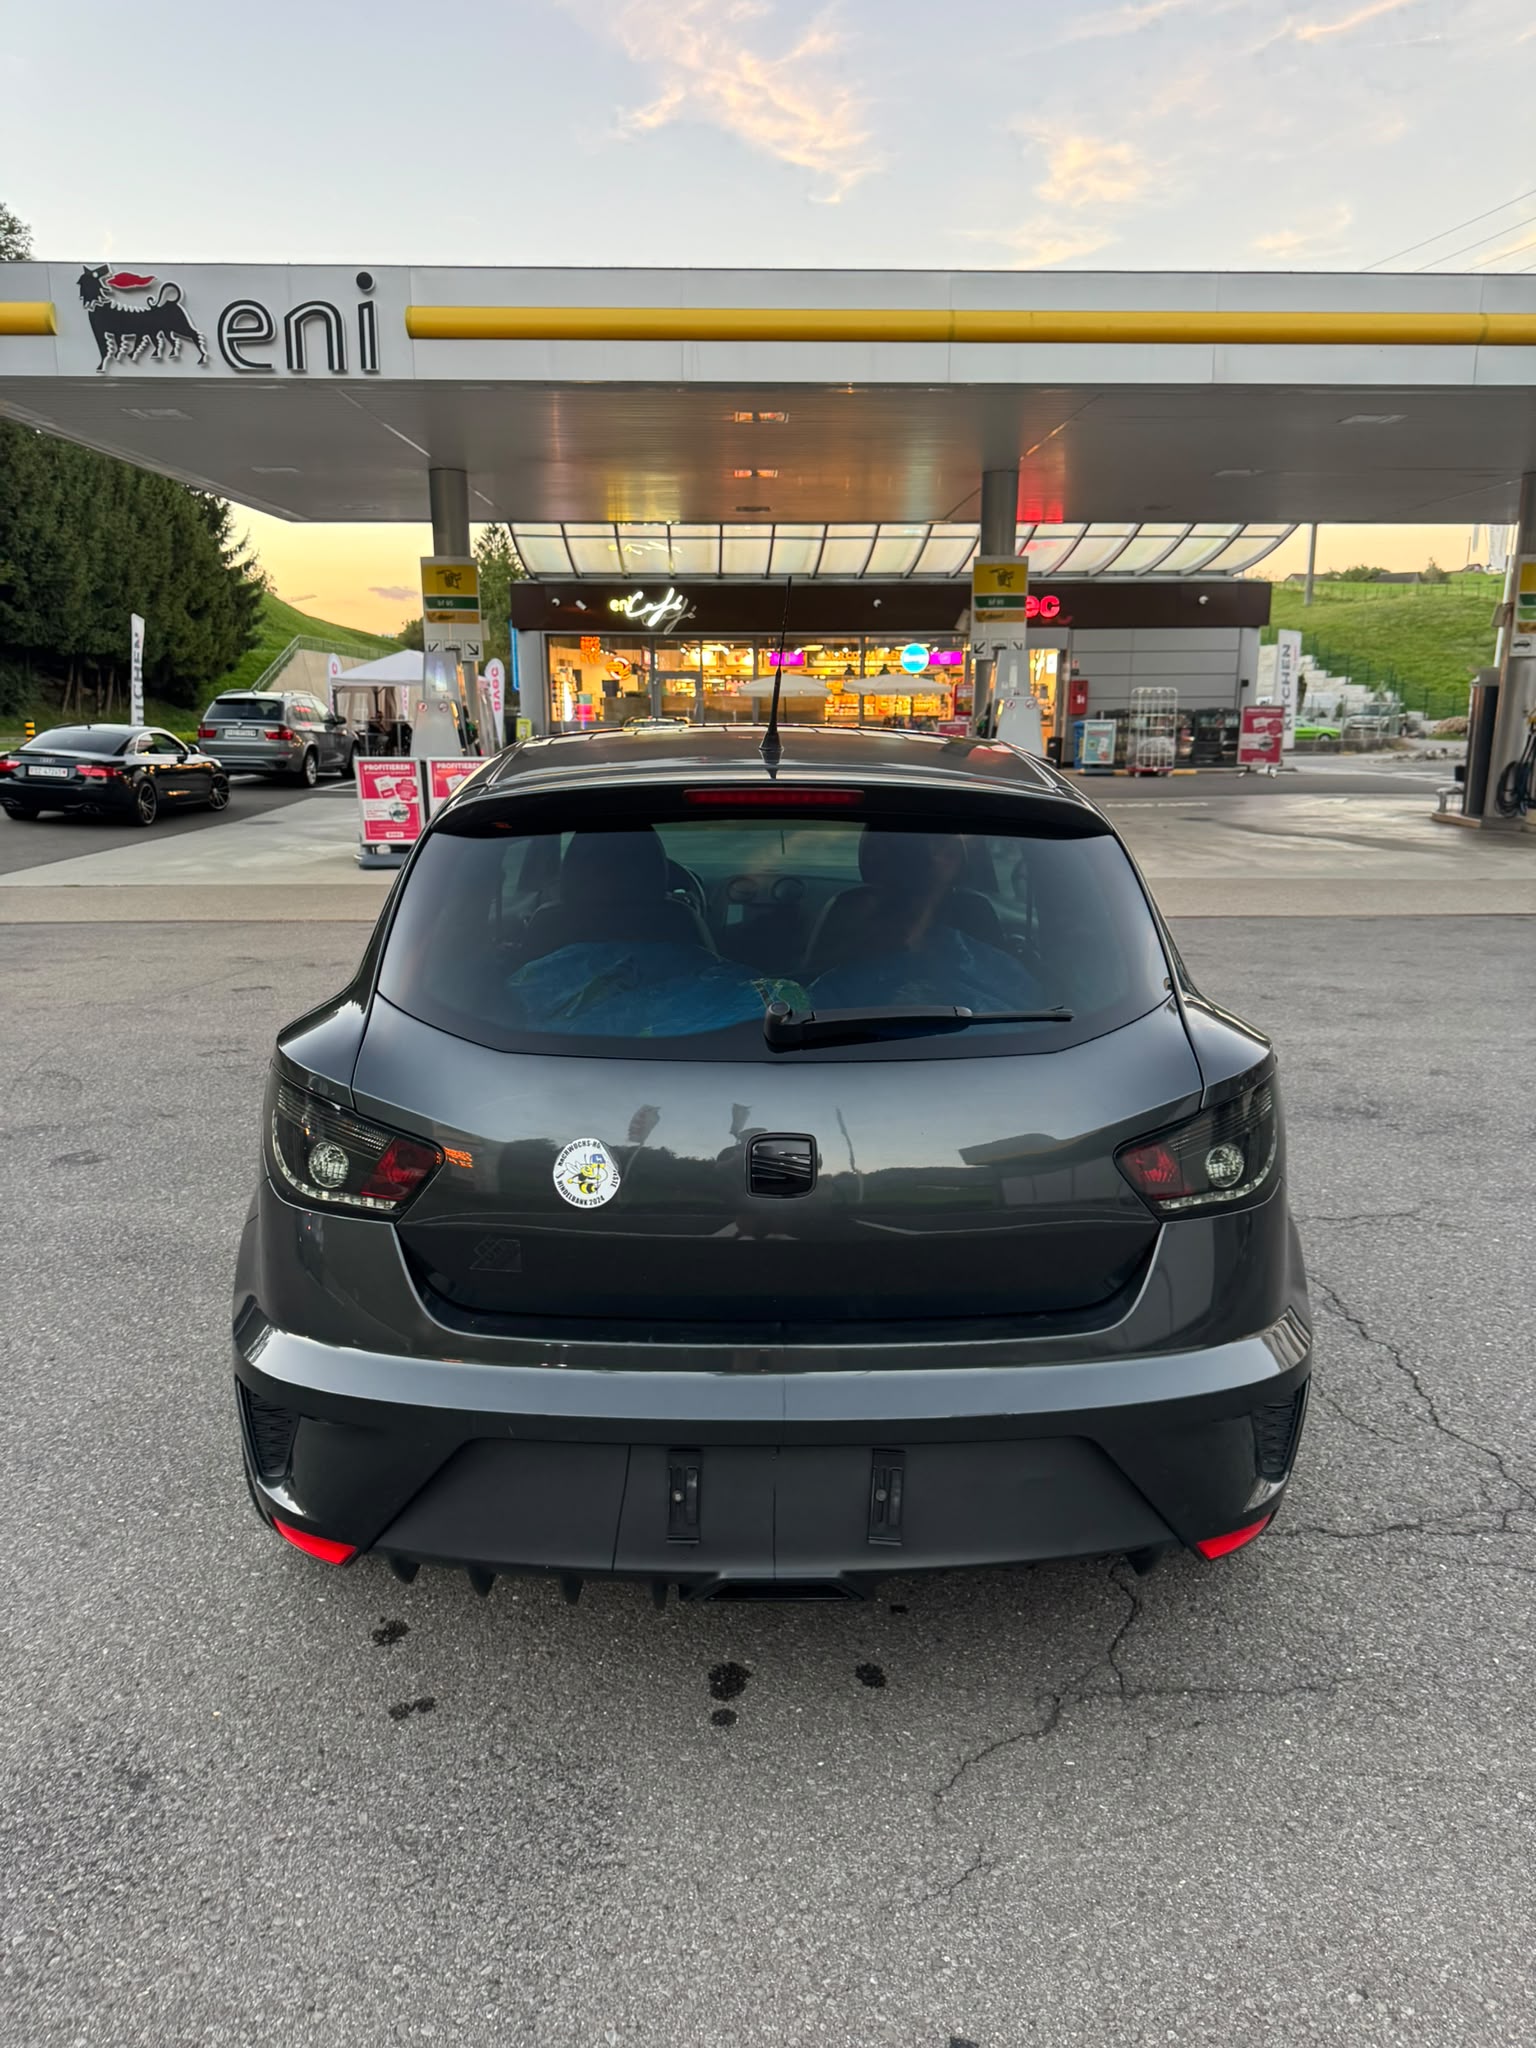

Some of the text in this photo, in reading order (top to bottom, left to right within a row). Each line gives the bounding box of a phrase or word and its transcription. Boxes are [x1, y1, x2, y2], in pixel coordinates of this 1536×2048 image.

[217, 271, 380, 372] eni
[609, 596, 633, 612] eni
[1281, 644, 1292, 731] KITCHEN
[556, 1180, 606, 1206] HINDELBANK 2024
